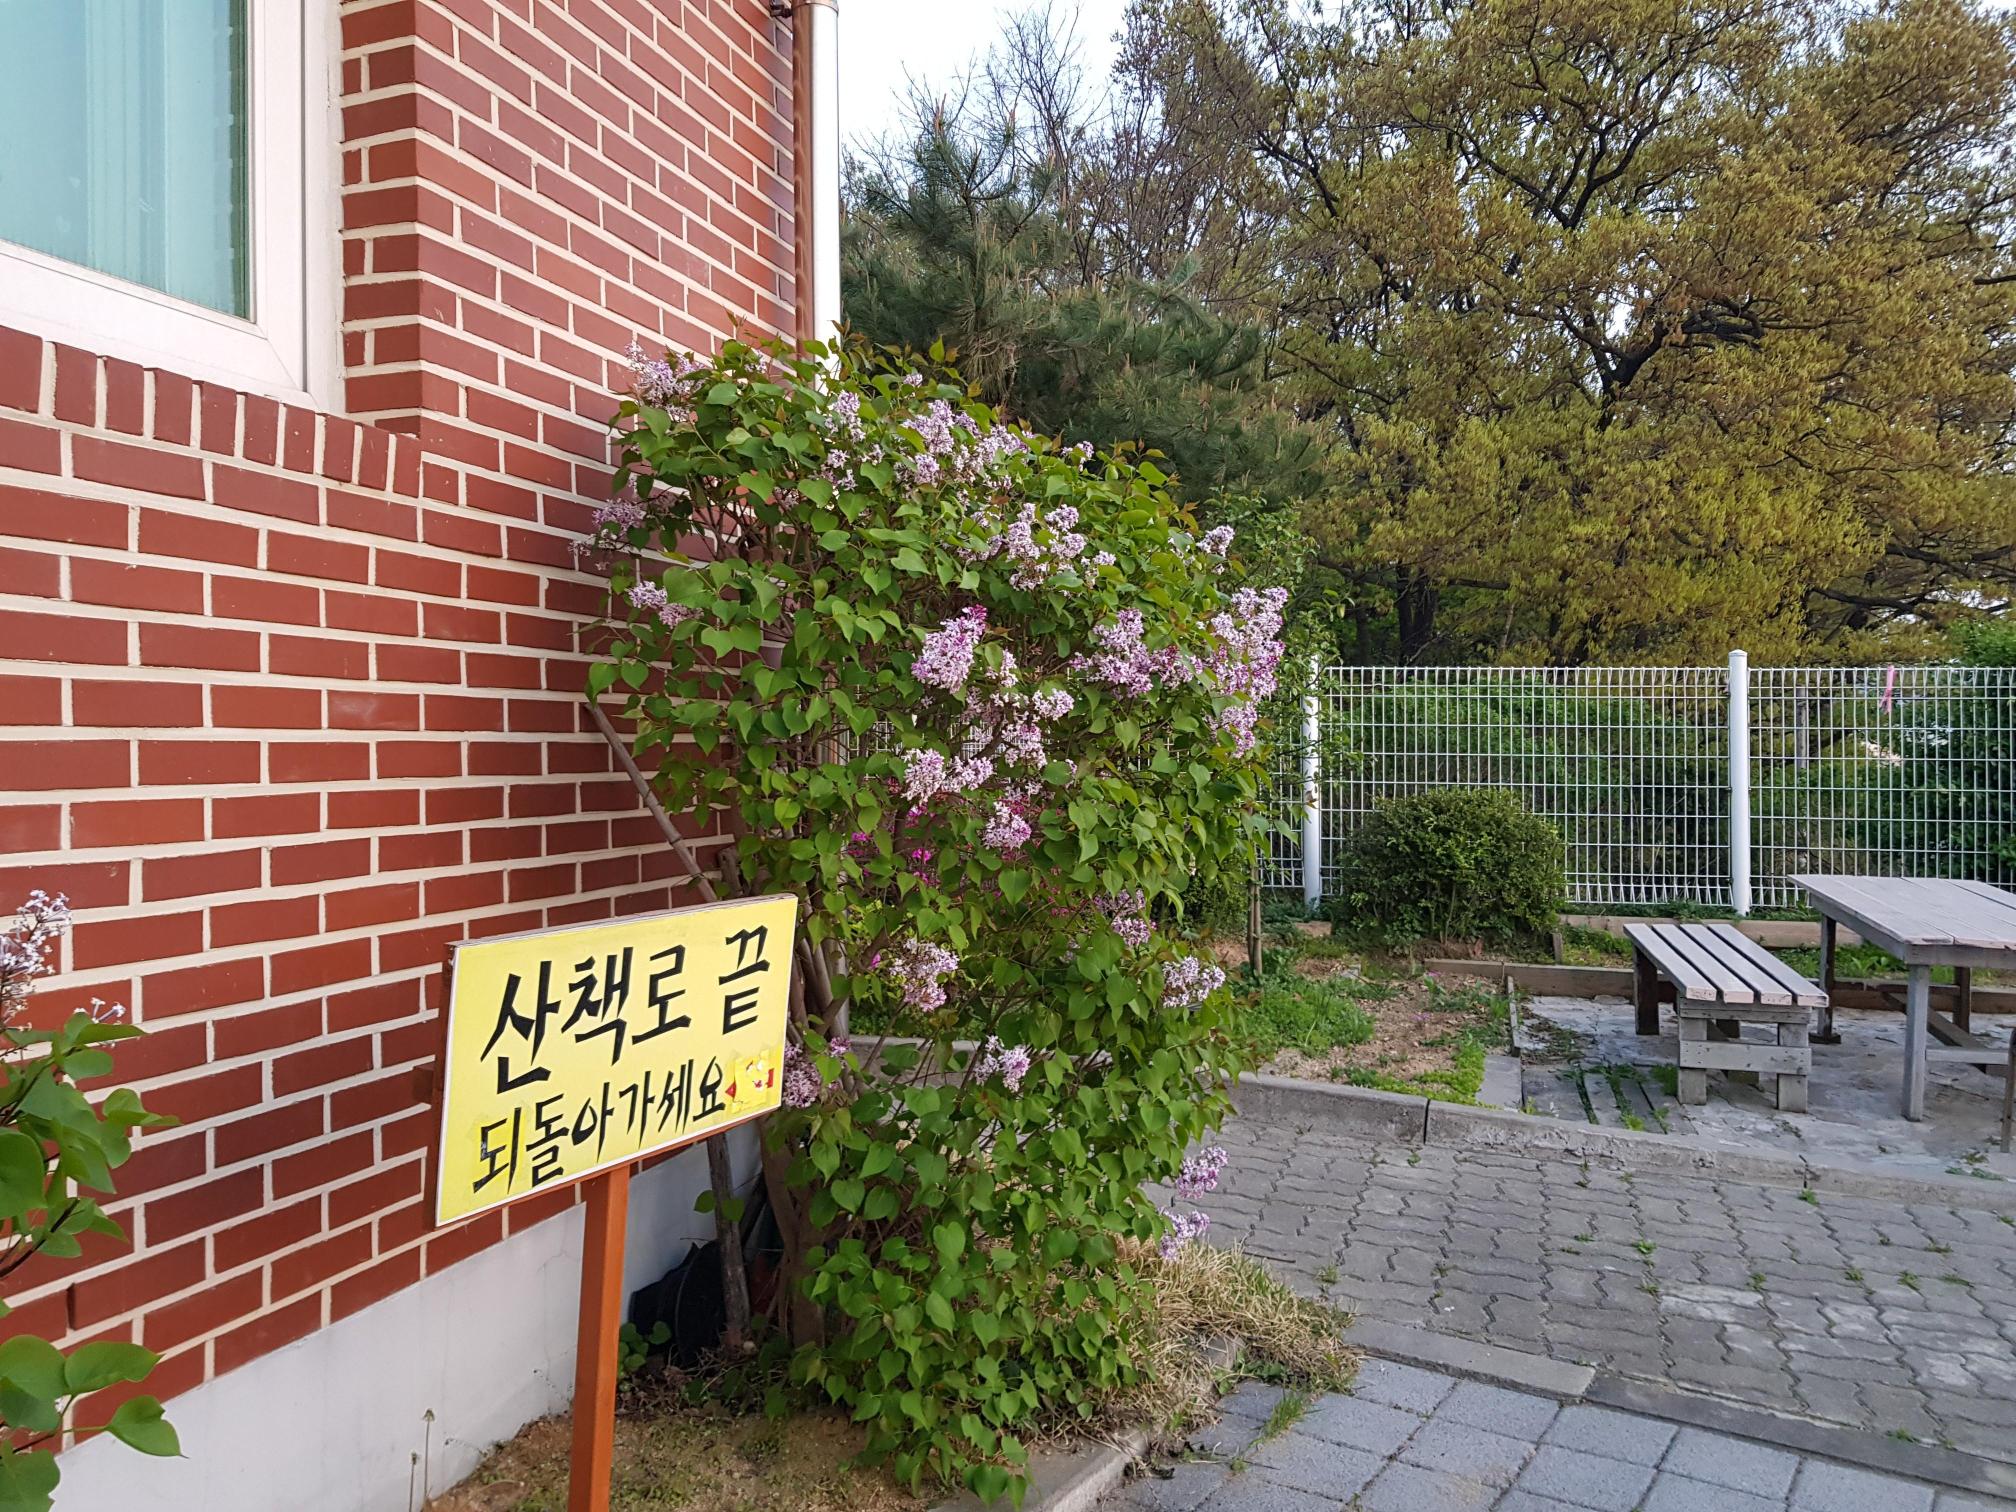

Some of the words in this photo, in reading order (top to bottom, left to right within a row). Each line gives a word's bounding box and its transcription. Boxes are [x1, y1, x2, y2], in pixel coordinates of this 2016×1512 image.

[480, 944, 692, 1094] 산책로
[718, 925, 770, 1035] 끝
[472, 1055, 726, 1194] 되돌아가세요
